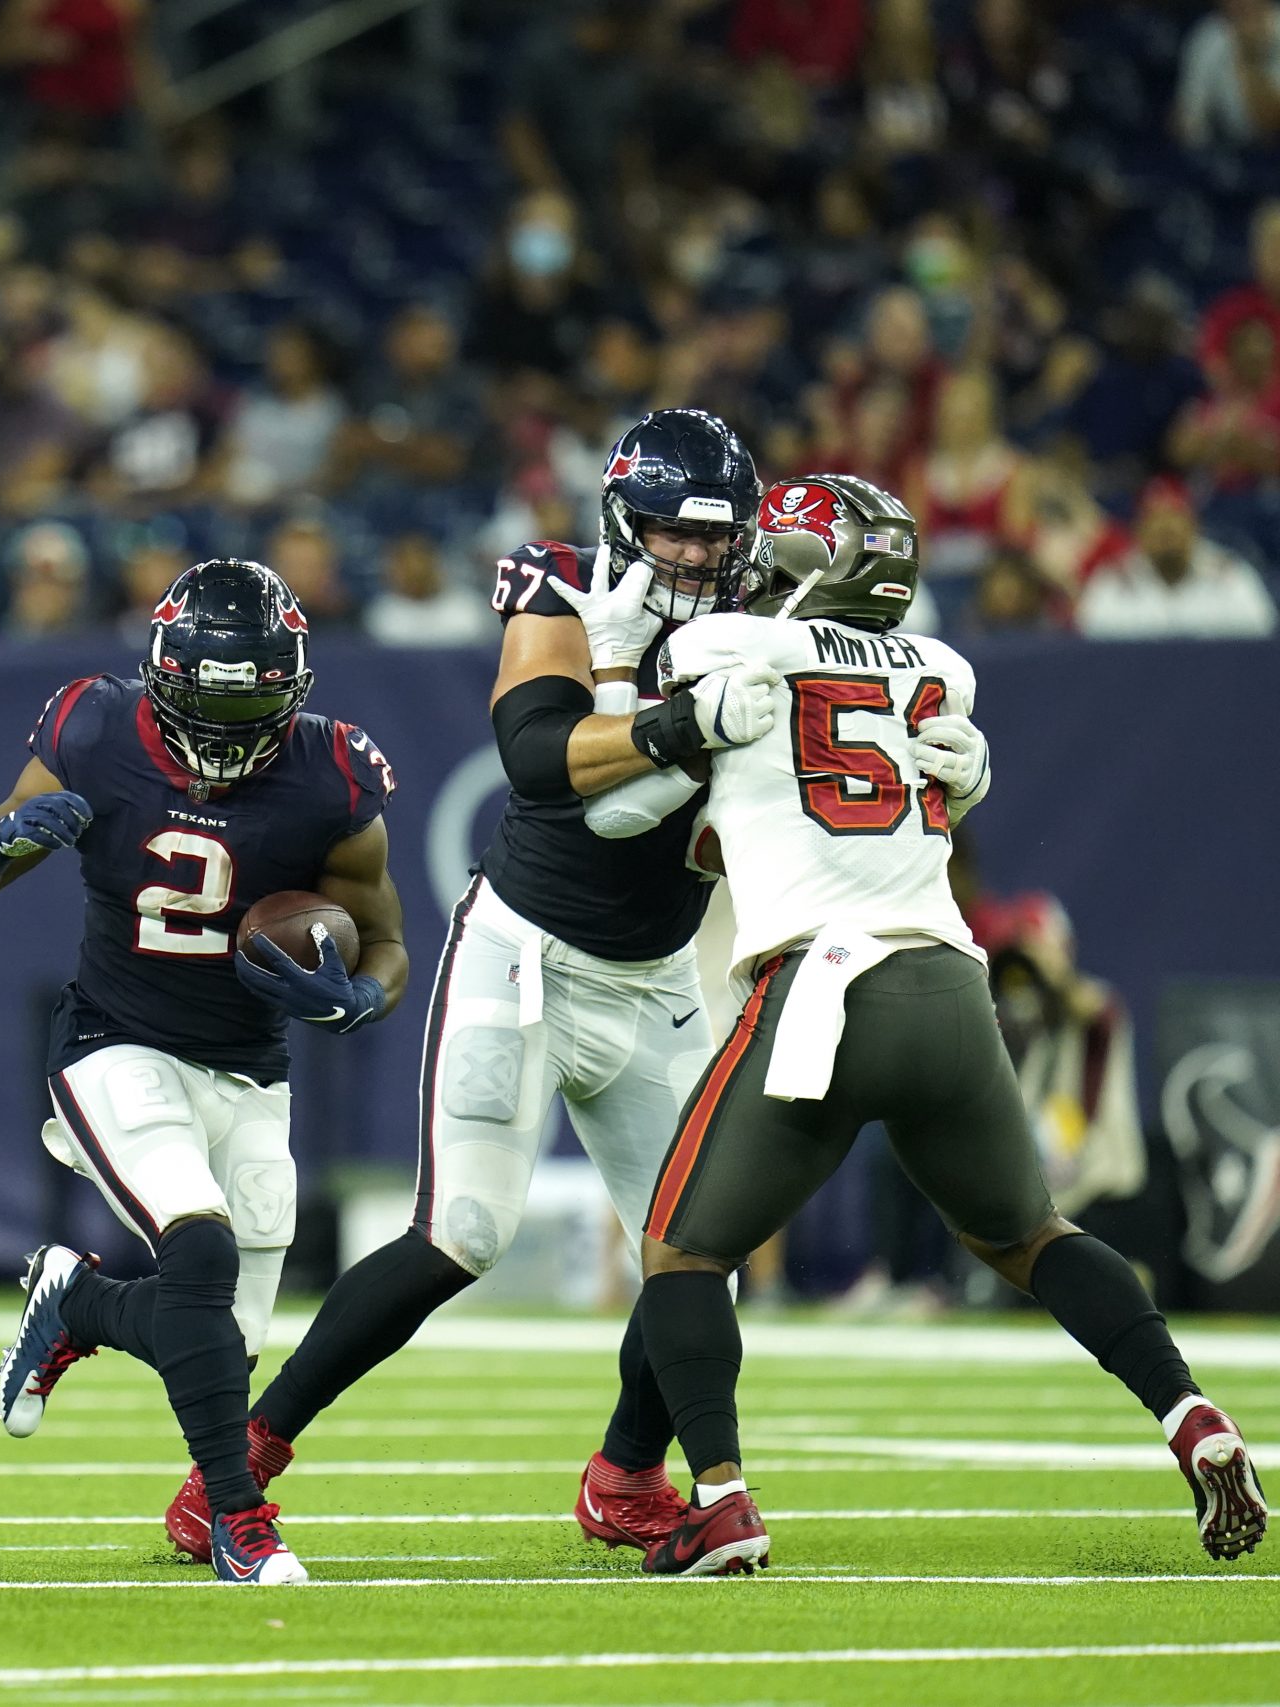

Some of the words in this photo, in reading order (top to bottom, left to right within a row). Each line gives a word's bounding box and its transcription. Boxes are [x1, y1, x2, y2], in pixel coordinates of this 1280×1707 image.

[692, 500, 726, 508] TEXANS
[491, 558, 545, 612] 67
[808, 624, 926, 669] MINTER
[167, 809, 228, 828] TEXANS
[131, 826, 238, 959] 2
[825, 952, 842, 965] NFL
